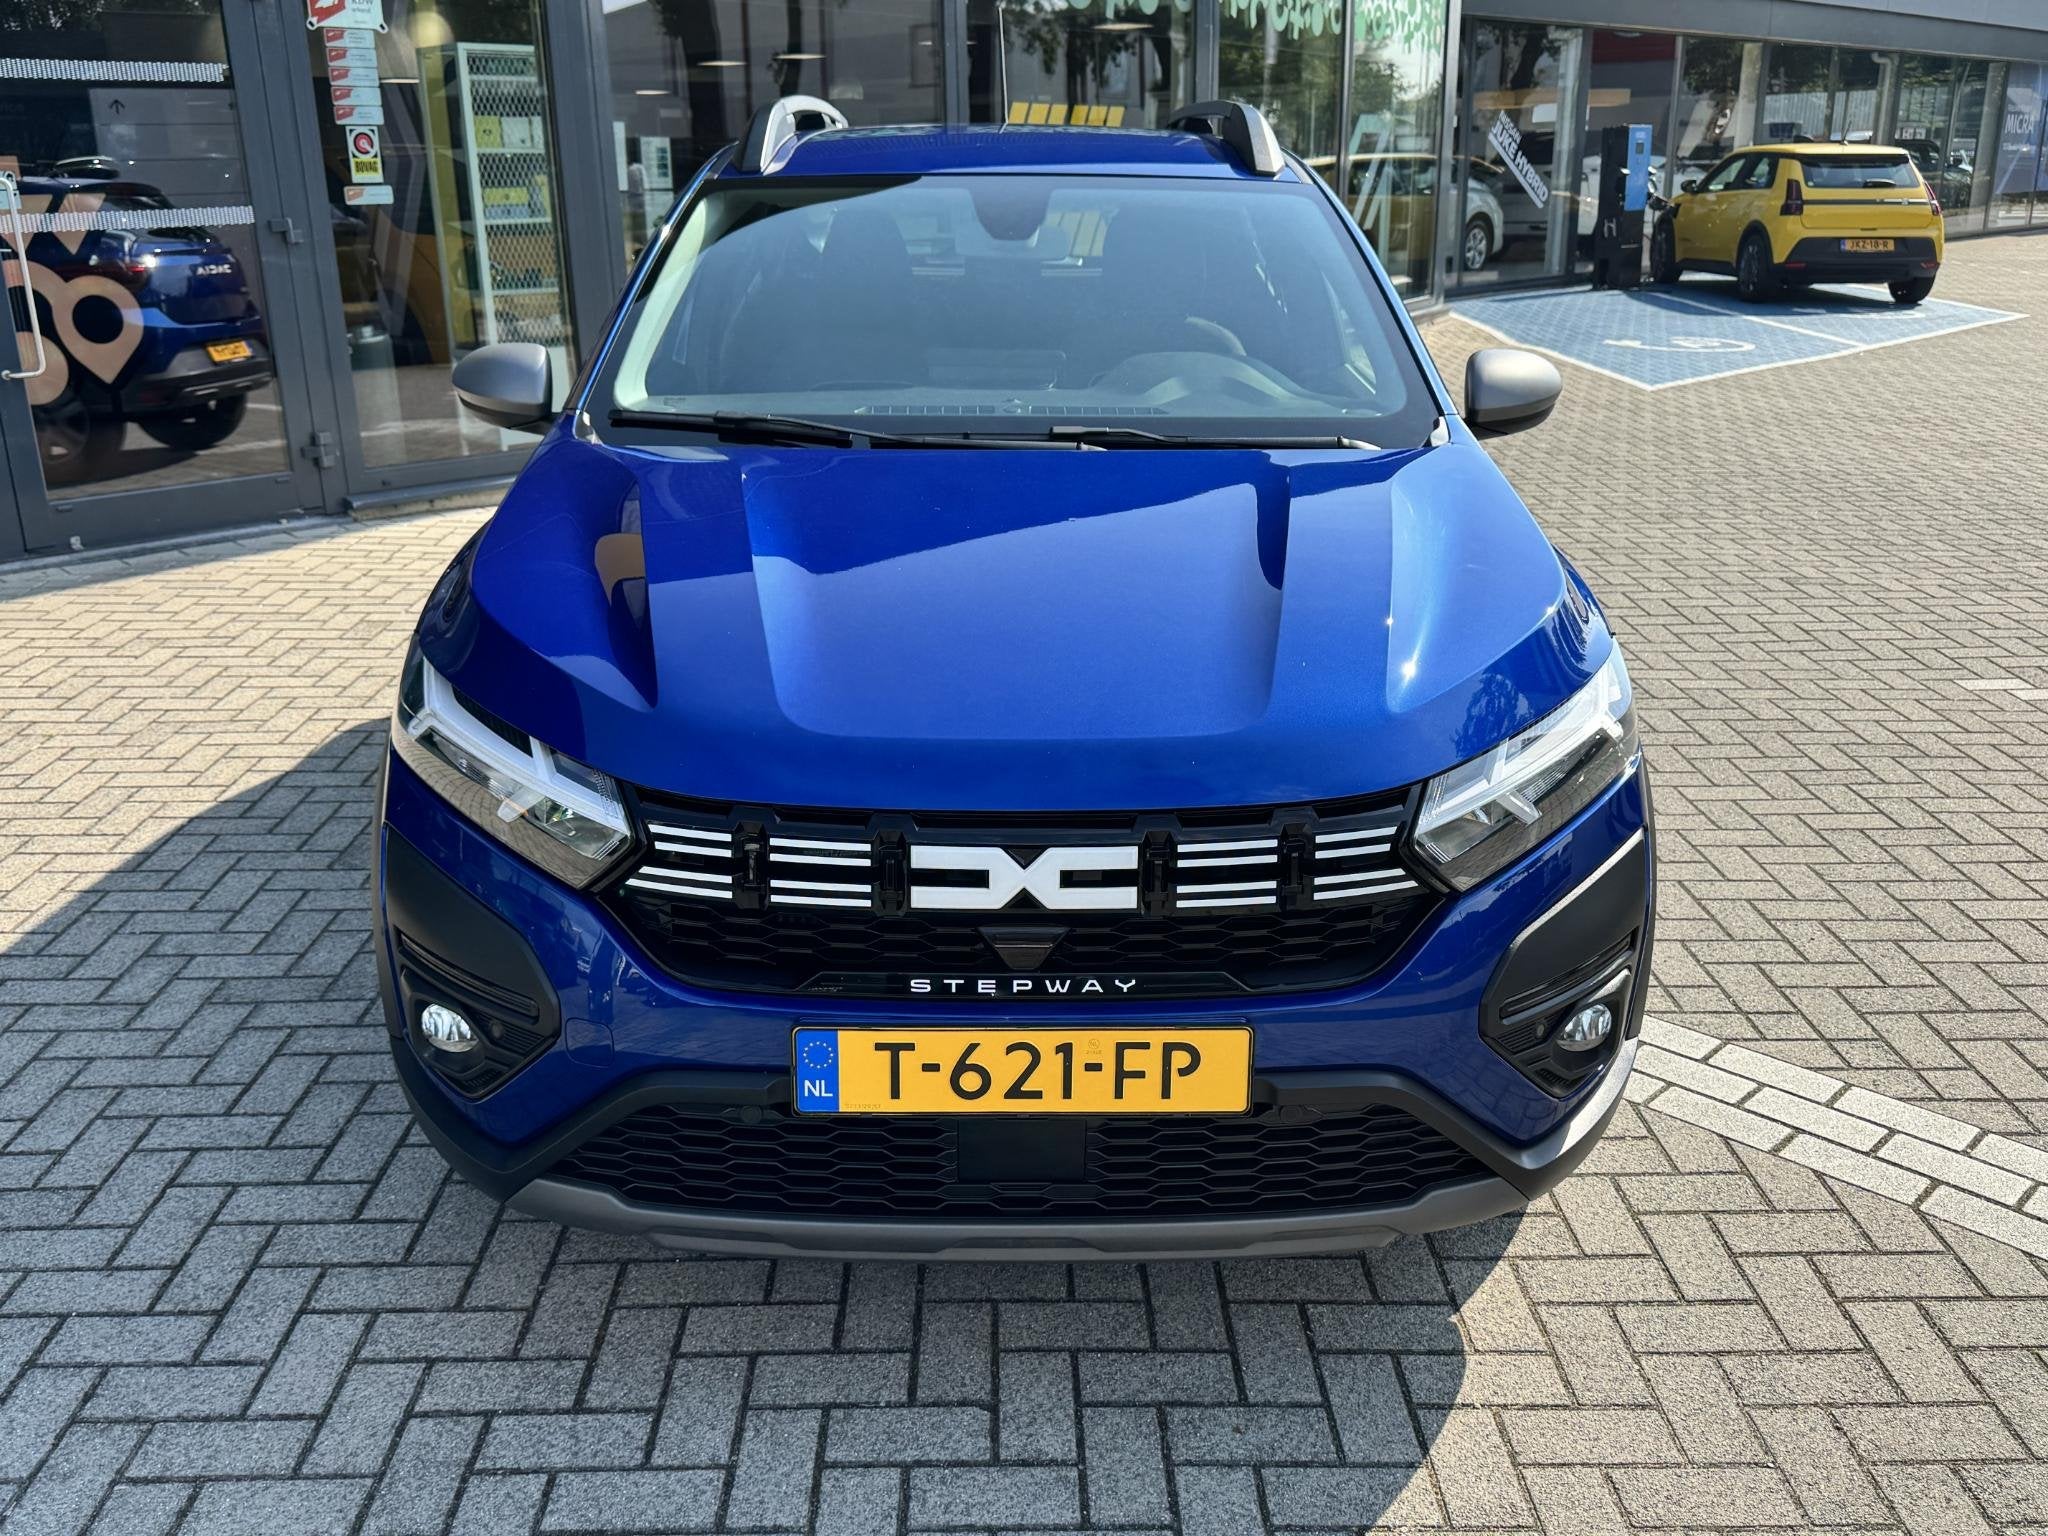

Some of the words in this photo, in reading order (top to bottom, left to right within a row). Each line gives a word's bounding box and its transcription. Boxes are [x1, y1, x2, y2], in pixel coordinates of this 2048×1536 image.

[2005, 113, 2034, 134] MICRA
[1491, 121, 1518, 160] JUKE
[1514, 150, 1549, 202] HYBRID
[910, 979, 1136, 993] STEPWAY
[874, 1042, 1202, 1101] T-621-FP
[804, 1079, 834, 1097] NL
